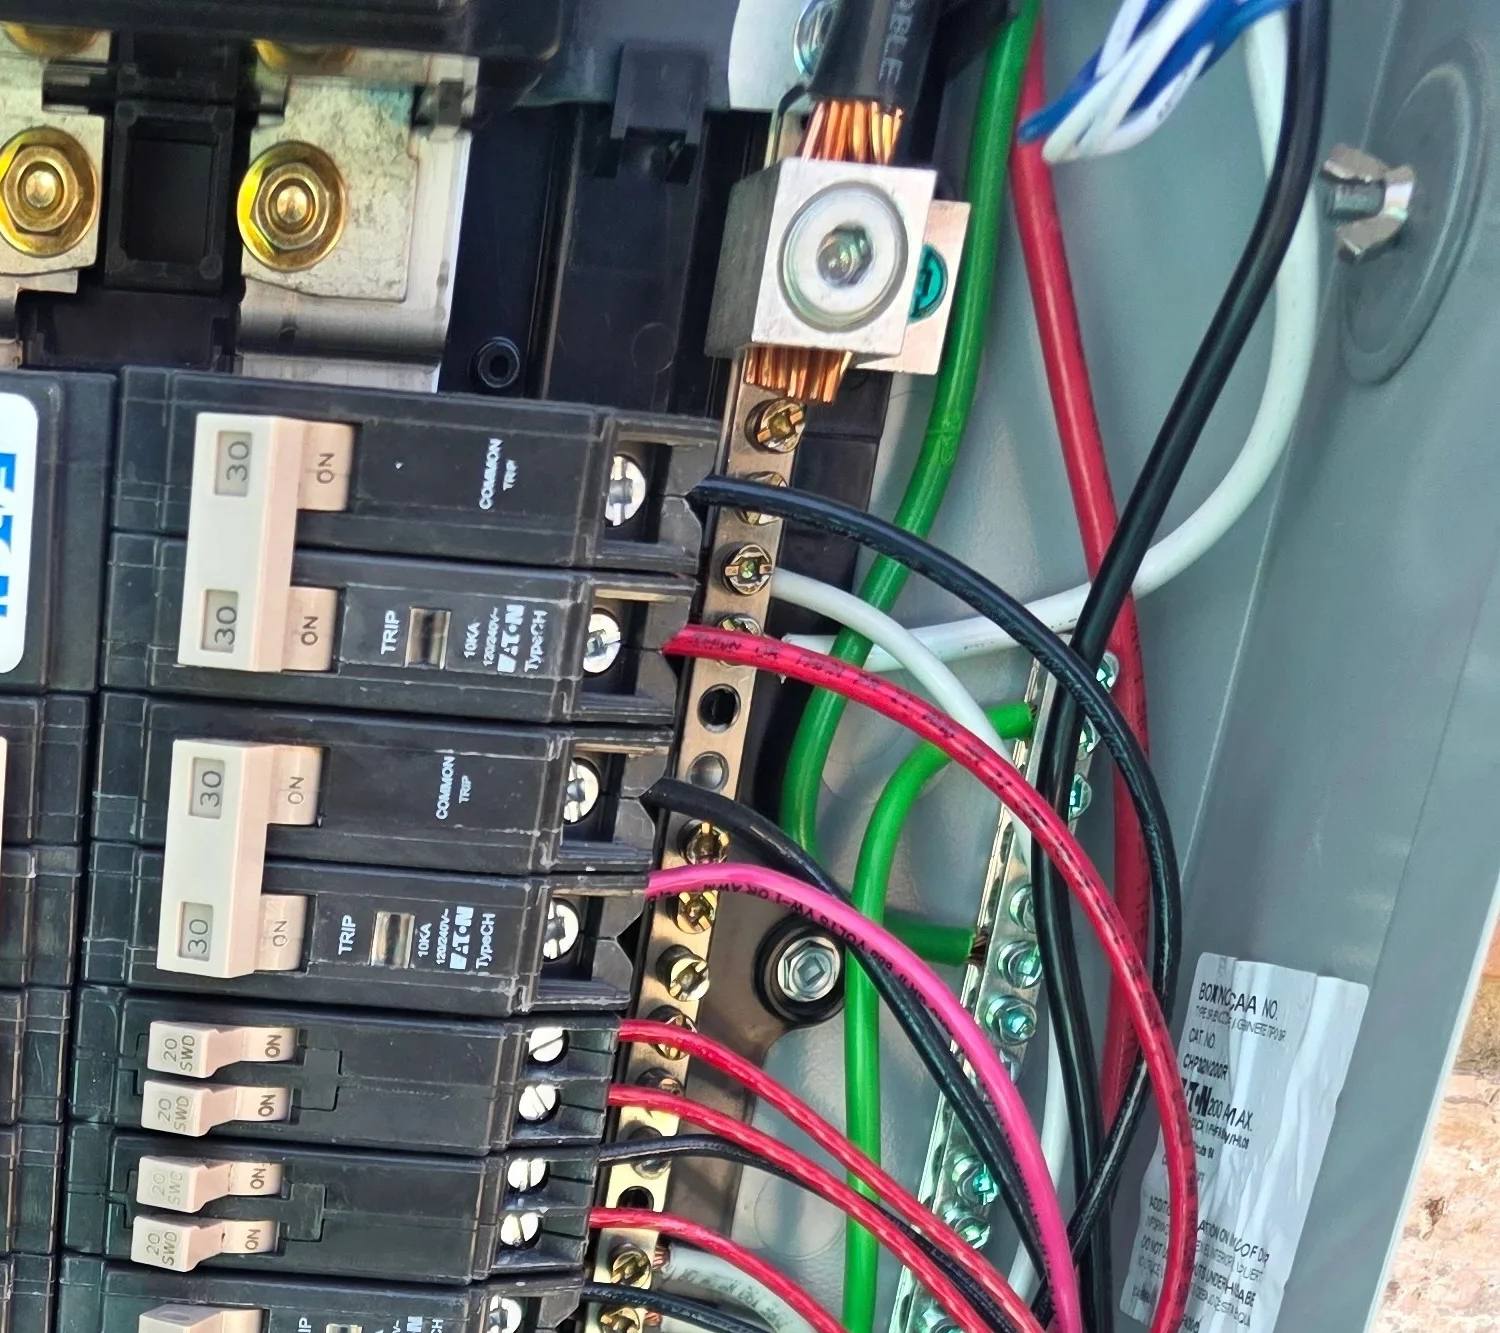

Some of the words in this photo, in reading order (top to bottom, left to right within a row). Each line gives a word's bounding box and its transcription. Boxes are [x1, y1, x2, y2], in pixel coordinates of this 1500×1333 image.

[225, 438, 250, 483] 30
[316, 451, 336, 485] ON
[215, 605, 237, 646] 30
[301, 615, 320, 647] ON
[380, 610, 400, 655] TRIP
[199, 770, 223, 808] 30
[288, 776, 305, 805] ON
[188, 918, 209, 954] 30
[272, 919, 289, 947] ON
[338, 914, 357, 955] TRIP
[162, 1037, 178, 1062] 20
[180, 1034, 195, 1072] SWD
[265, 1034, 282, 1058] ON
[258, 1093, 275, 1118] ON
[146, 1232, 160, 1256] 20
[161, 1230, 179, 1266] SWD
[245, 1228, 261, 1251] ON
